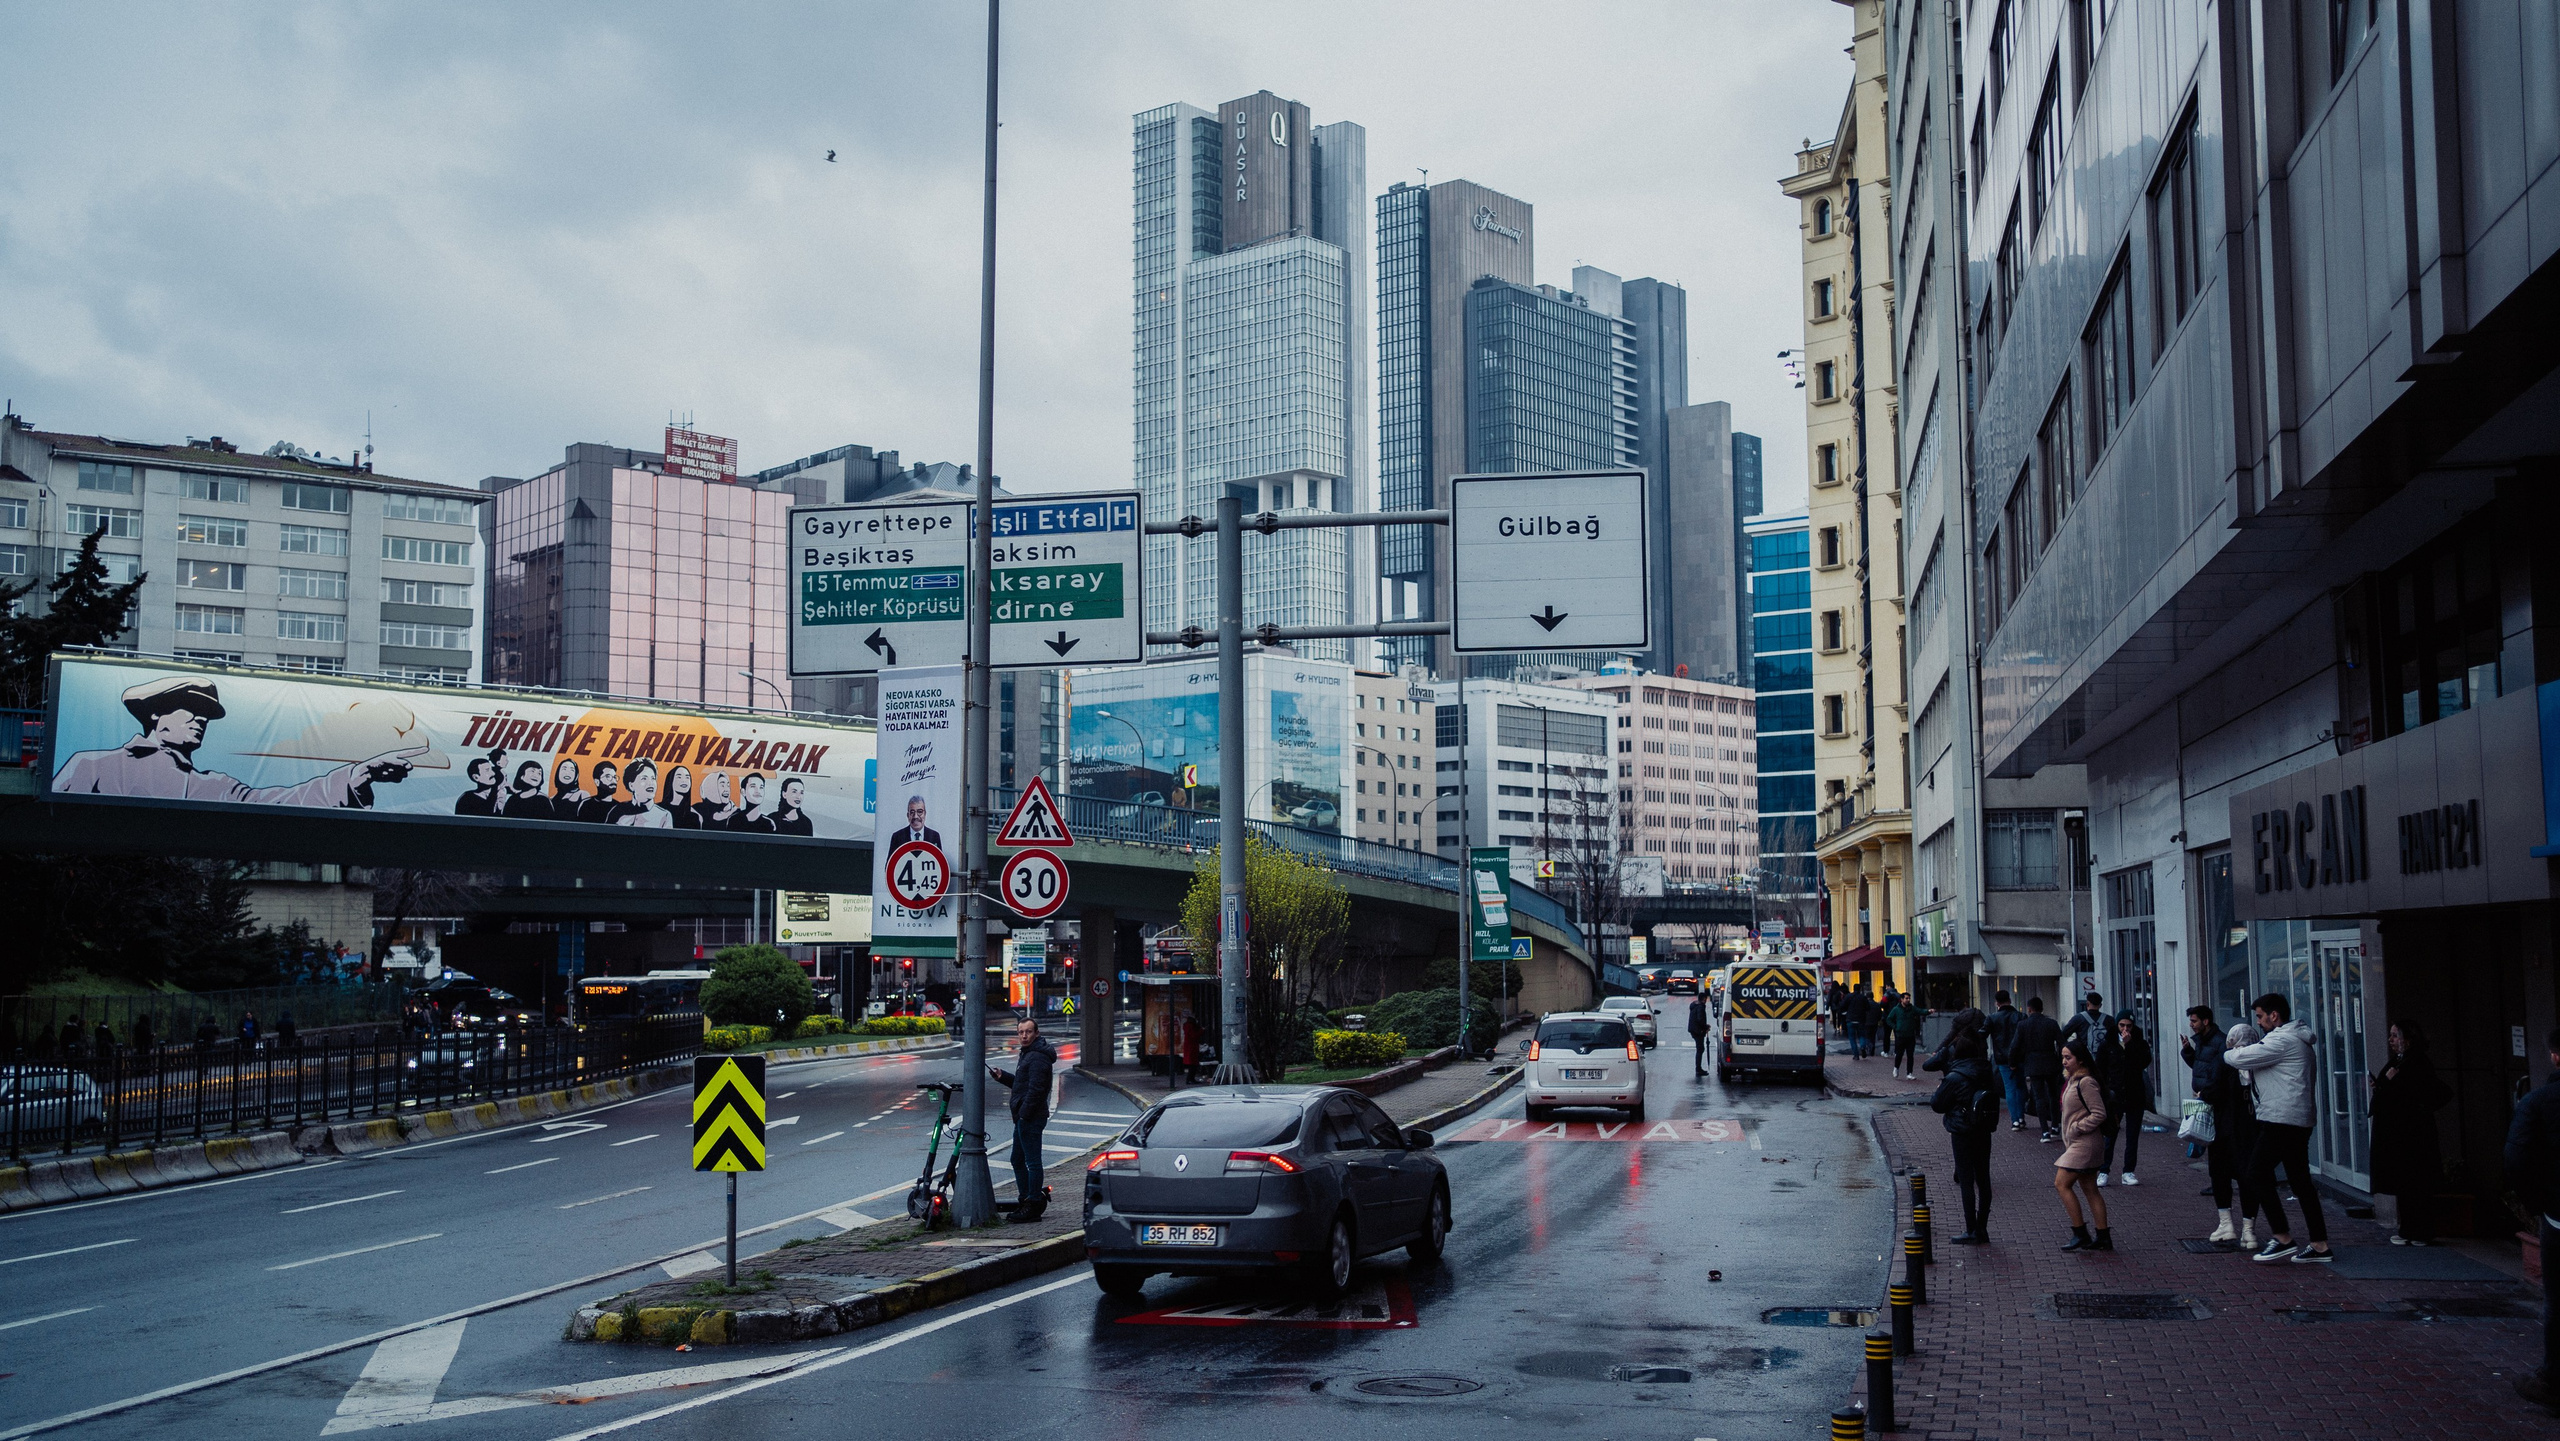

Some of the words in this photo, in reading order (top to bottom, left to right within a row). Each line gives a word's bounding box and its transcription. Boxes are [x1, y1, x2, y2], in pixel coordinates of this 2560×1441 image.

[1270, 111, 1287, 147] Q
[1236, 111, 1247, 202] QUASAR
[1473, 205, 1524, 244] Fairmont
[804, 515, 952, 538] Gayrettepe
[1038, 507, 1104, 531] Etfal
[1498, 515, 1600, 540] Gülbağ
[804, 547, 914, 567] Beşiktaş
[992, 542, 1076, 562] aksim
[807, 574, 828, 592] 15
[833, 573, 909, 591] Temmuz
[804, 601, 877, 621] Şehitler
[883, 597, 960, 619] Köprüsü
[990, 600, 1074, 620] dirne
[1308, 675, 1340, 686] HYUNDAI
[1408, 682, 1434, 698] divan
[886, 691, 914, 700] NEOVA
[915, 688, 942, 698] KASKO
[885, 700, 928, 711] SİGORTASI
[929, 699, 956, 708] VARSA
[885, 711, 928, 721] HAYATINIZ
[929, 710, 947, 719] YARI
[1278, 714, 1308, 726] Hyundai
[885, 722, 912, 731] YOLDA
[914, 720, 949, 730] KALMAZ!
[1278, 726, 1311, 738] değişime
[461, 710, 602, 756] TÜRKİYE
[600, 725, 695, 762] TARİH
[693, 736, 830, 773] YAZACAK
[1278, 737, 1292, 748] güç
[1293, 740, 1319, 750] veriyor.
[1075, 743, 1098, 761] güç
[2252, 784, 2369, 894] ERCAN
[1015, 868, 1056, 898] 30
[1489, 944, 1510, 953] PRATİK
[1741, 987, 1771, 997] OKUL
[1149, 1227, 1164, 1240] 35
[1169, 1227, 1187, 1240] RH
[1192, 1228, 1215, 1241] 852
